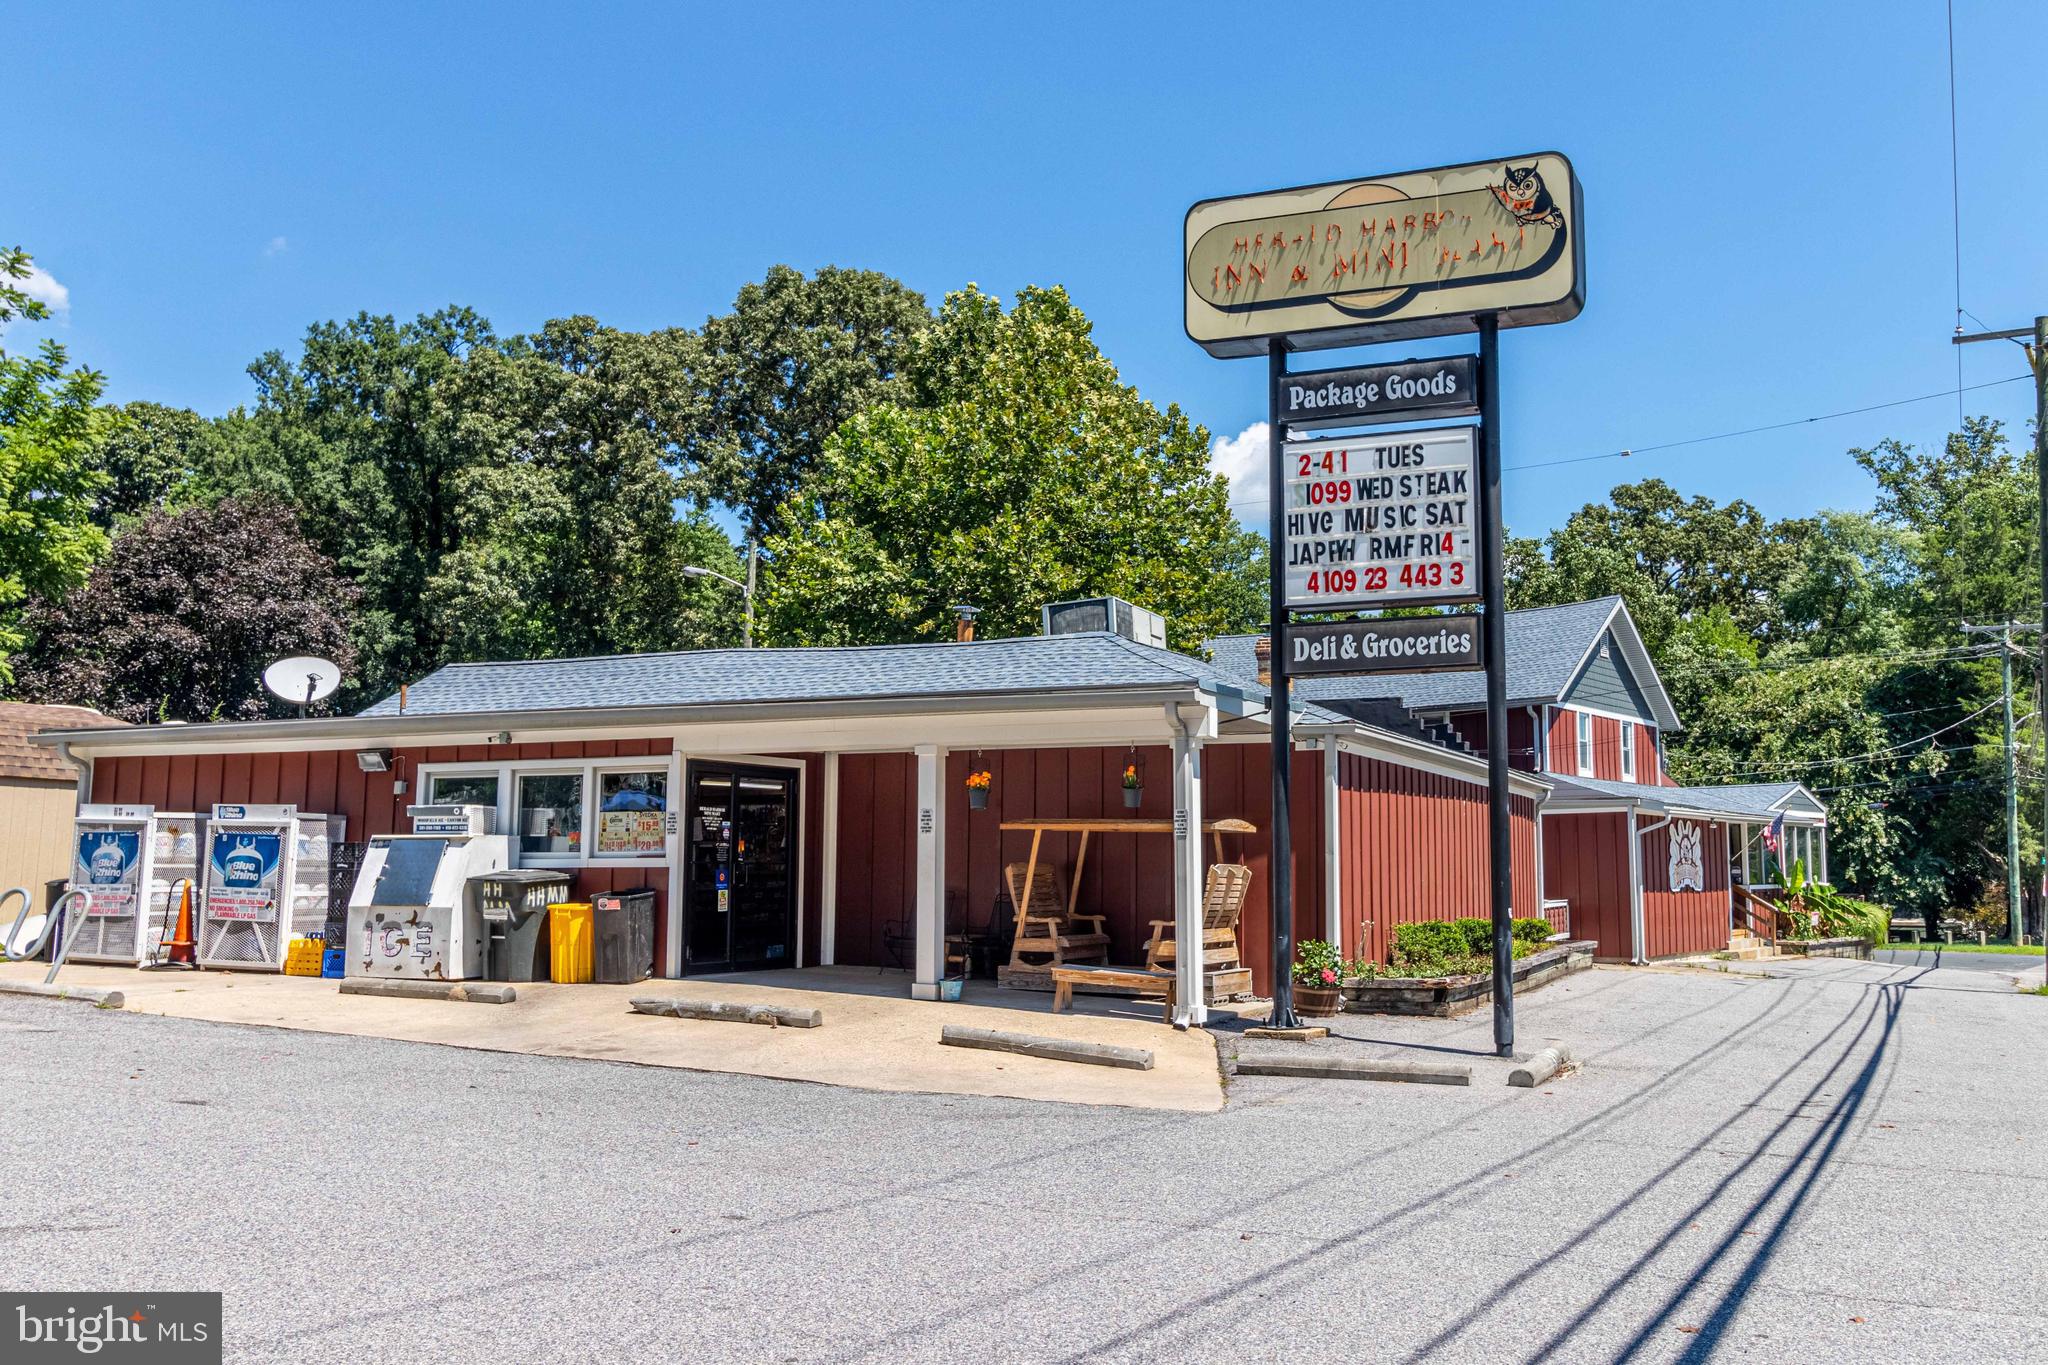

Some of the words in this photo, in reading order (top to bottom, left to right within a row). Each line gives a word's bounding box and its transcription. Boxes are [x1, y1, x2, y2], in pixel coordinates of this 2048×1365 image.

[1289, 380, 1379, 410] Package
[1385, 369, 1457, 400] Goods
[1374, 443, 1424, 469] TUES
[1356, 475, 1394, 501] WED
[1399, 470, 1468, 498] STEAK
[1344, 504, 1417, 533] MUSIC
[1425, 501, 1466, 526] SAT
[1293, 634, 1337, 662] Deli
[1340, 633, 1359, 660] &
[1362, 628, 1472, 658] Groceries
[98, 859, 118, 868] Blue
[233, 861, 256, 872] Blue
[362, 920, 433, 958] ICE
